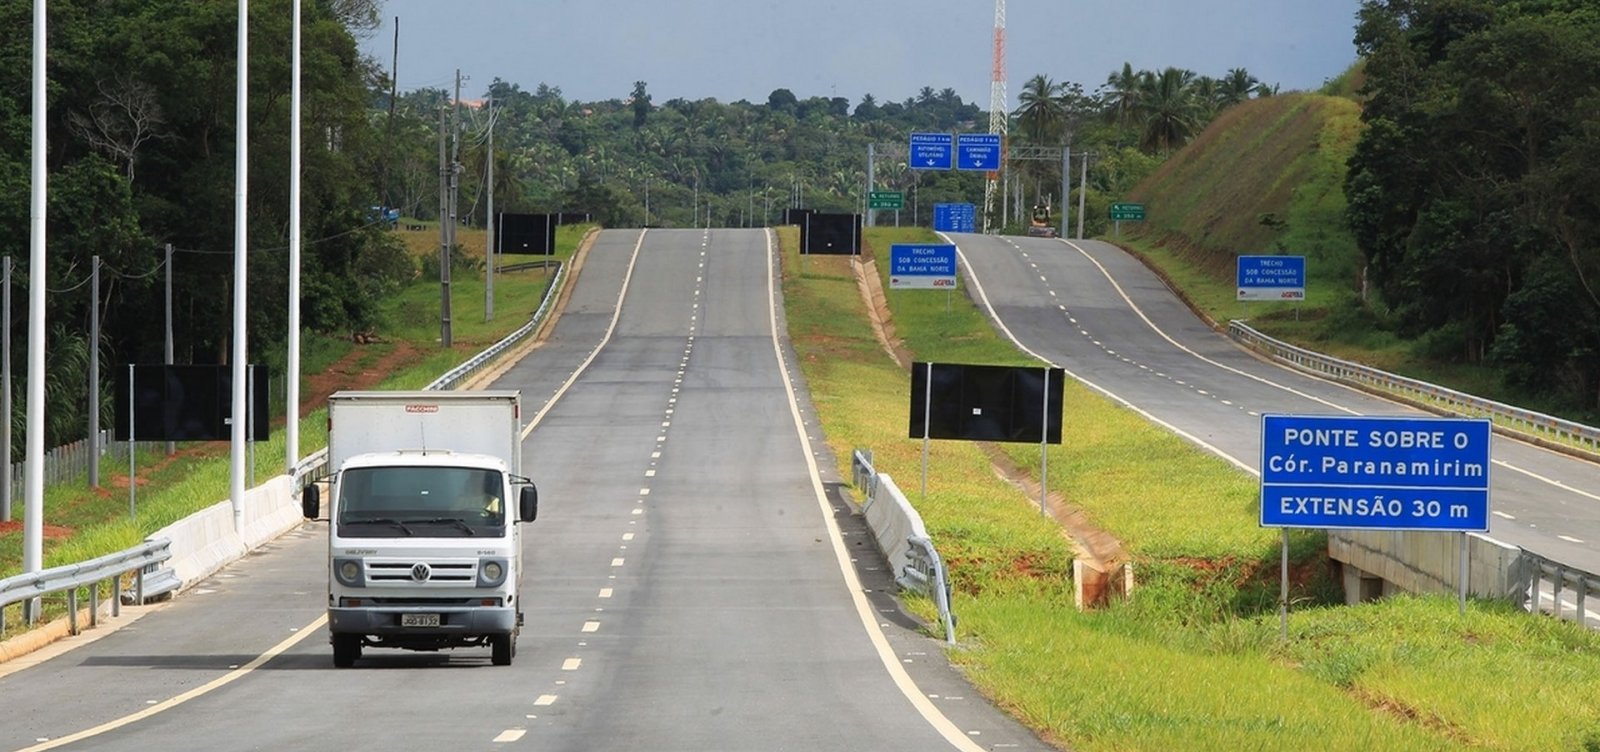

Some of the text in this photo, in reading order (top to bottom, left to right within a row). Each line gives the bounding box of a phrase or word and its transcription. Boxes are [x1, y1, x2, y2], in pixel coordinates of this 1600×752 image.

[1284, 428, 1468, 449] PONTE SOBRE O
[1269, 454, 1482, 477] Cór. Paranamirim
[1281, 496, 1468, 518] EXTENSÃO 30 m
